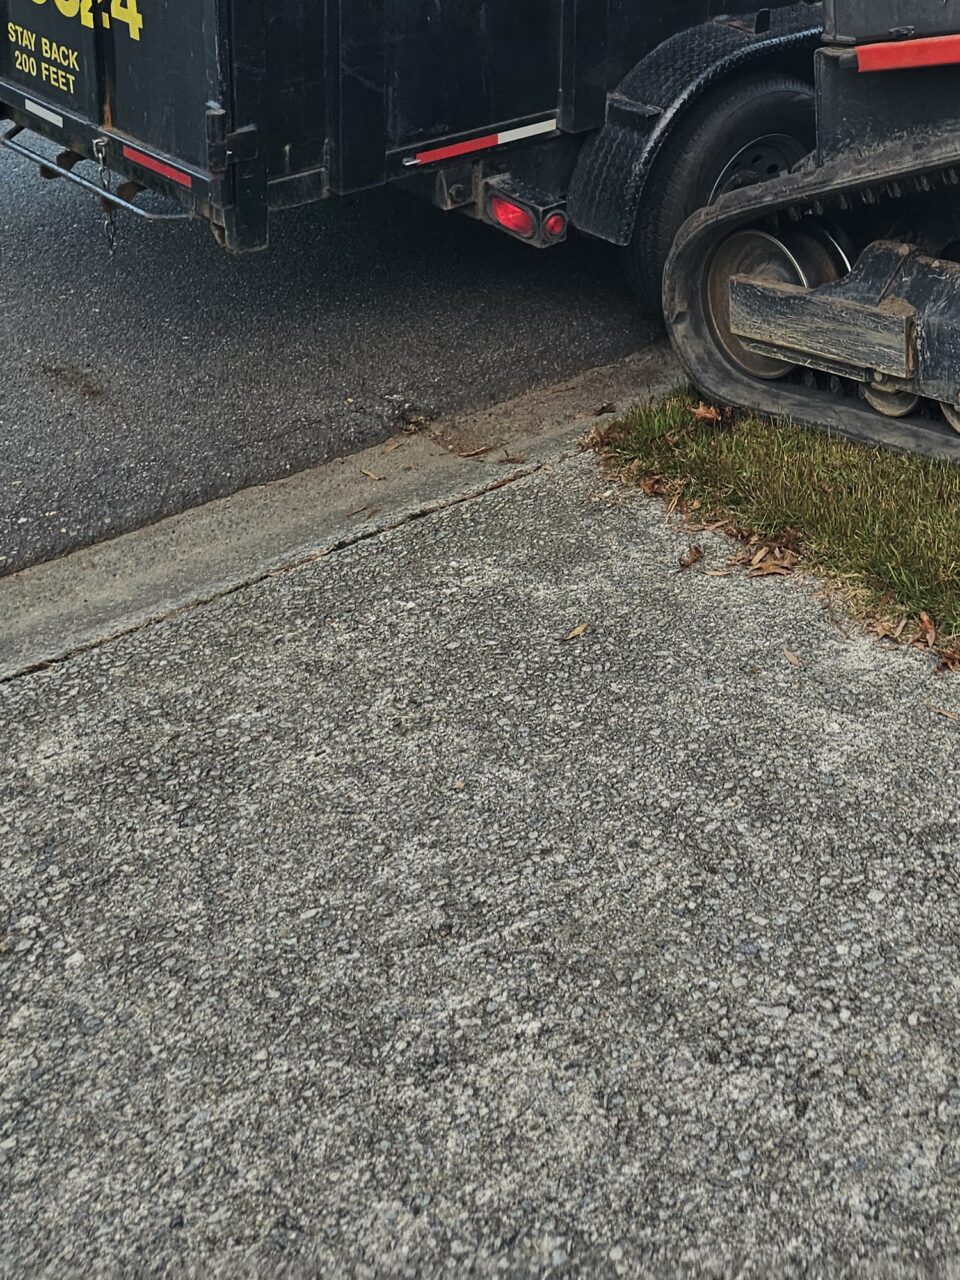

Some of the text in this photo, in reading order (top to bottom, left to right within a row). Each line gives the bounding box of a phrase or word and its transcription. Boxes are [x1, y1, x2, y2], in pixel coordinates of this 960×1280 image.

[8, 22, 80, 71] STAY BACK
[15, 50, 76, 94] 200 FEET
